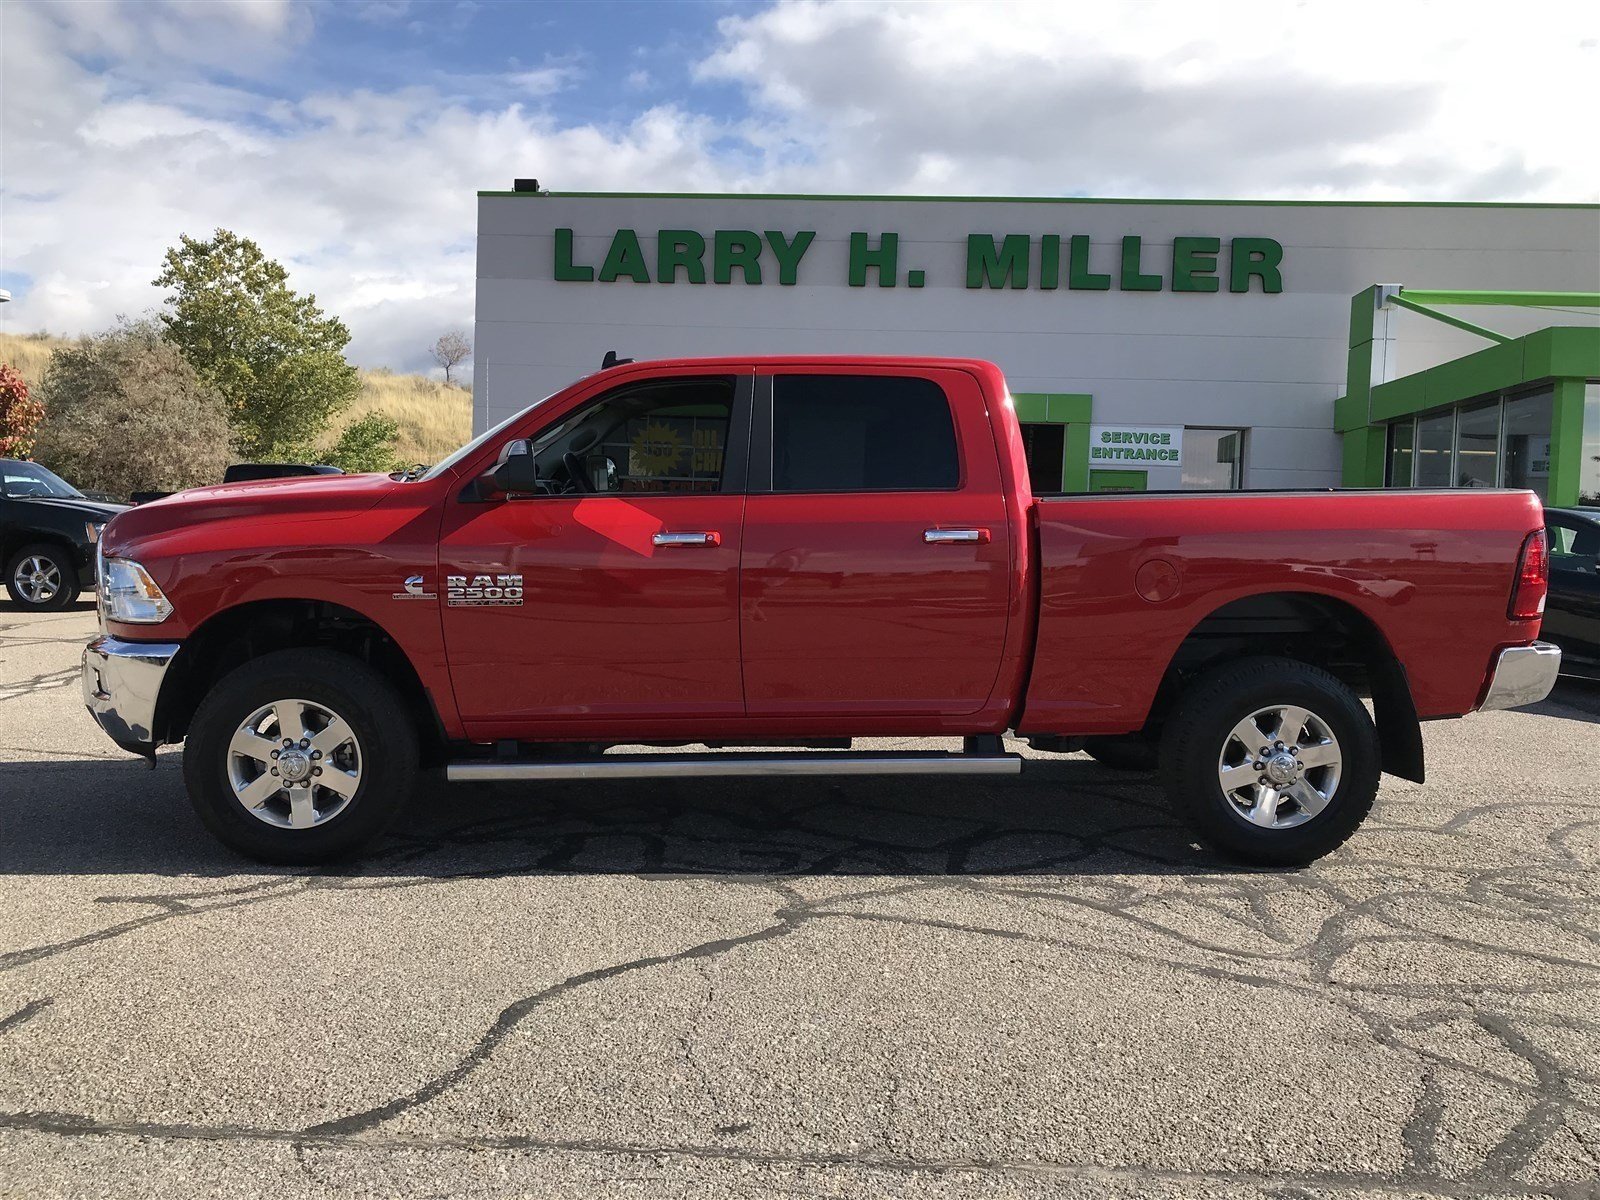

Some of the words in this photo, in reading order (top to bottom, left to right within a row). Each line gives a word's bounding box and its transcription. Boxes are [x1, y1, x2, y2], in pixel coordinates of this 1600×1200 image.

[555, 228, 816, 286] LARRY
[848, 232, 925, 288] H.
[966, 234, 1284, 293] MILLER
[1101, 431, 1171, 445] SERVICE
[1091, 447, 1179, 461] ENTRANCE
[447, 574, 523, 587] RAM
[447, 587, 523, 599] 2500
